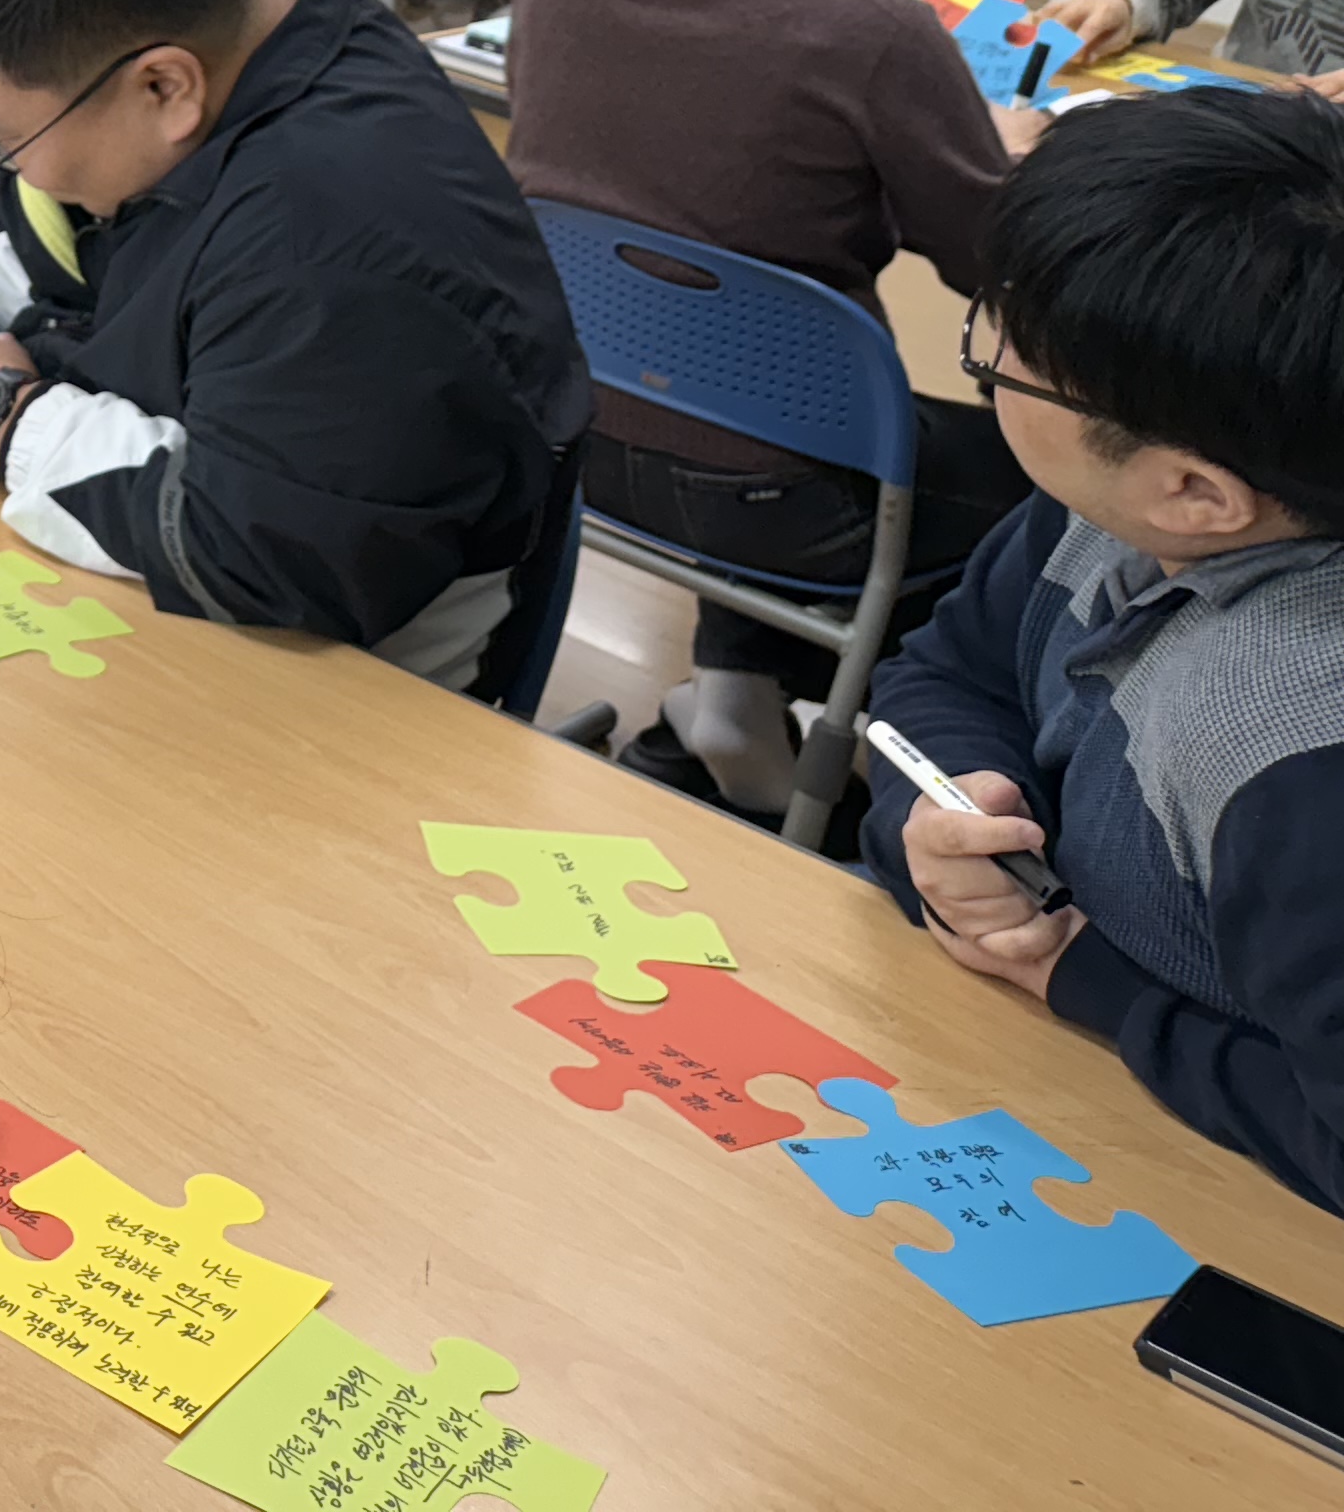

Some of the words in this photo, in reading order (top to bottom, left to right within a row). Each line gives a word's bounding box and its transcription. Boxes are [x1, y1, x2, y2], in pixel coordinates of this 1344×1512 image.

[96, 1245, 162, 1282] 신청하는
[176, 1282, 237, 1321] 연수에
[201, 1258, 242, 1288] 나는
[27, 1282, 141, 1349] 긍정적이다.
[75, 1264, 144, 1308] 참여할
[147, 1308, 176, 1327] 수
[153, 1386, 171, 1403] 수
[301, 1407, 341, 1439] 교육
[437, 1407, 483, 1443] 있다.
[310, 1460, 363, 1509] 상황은
